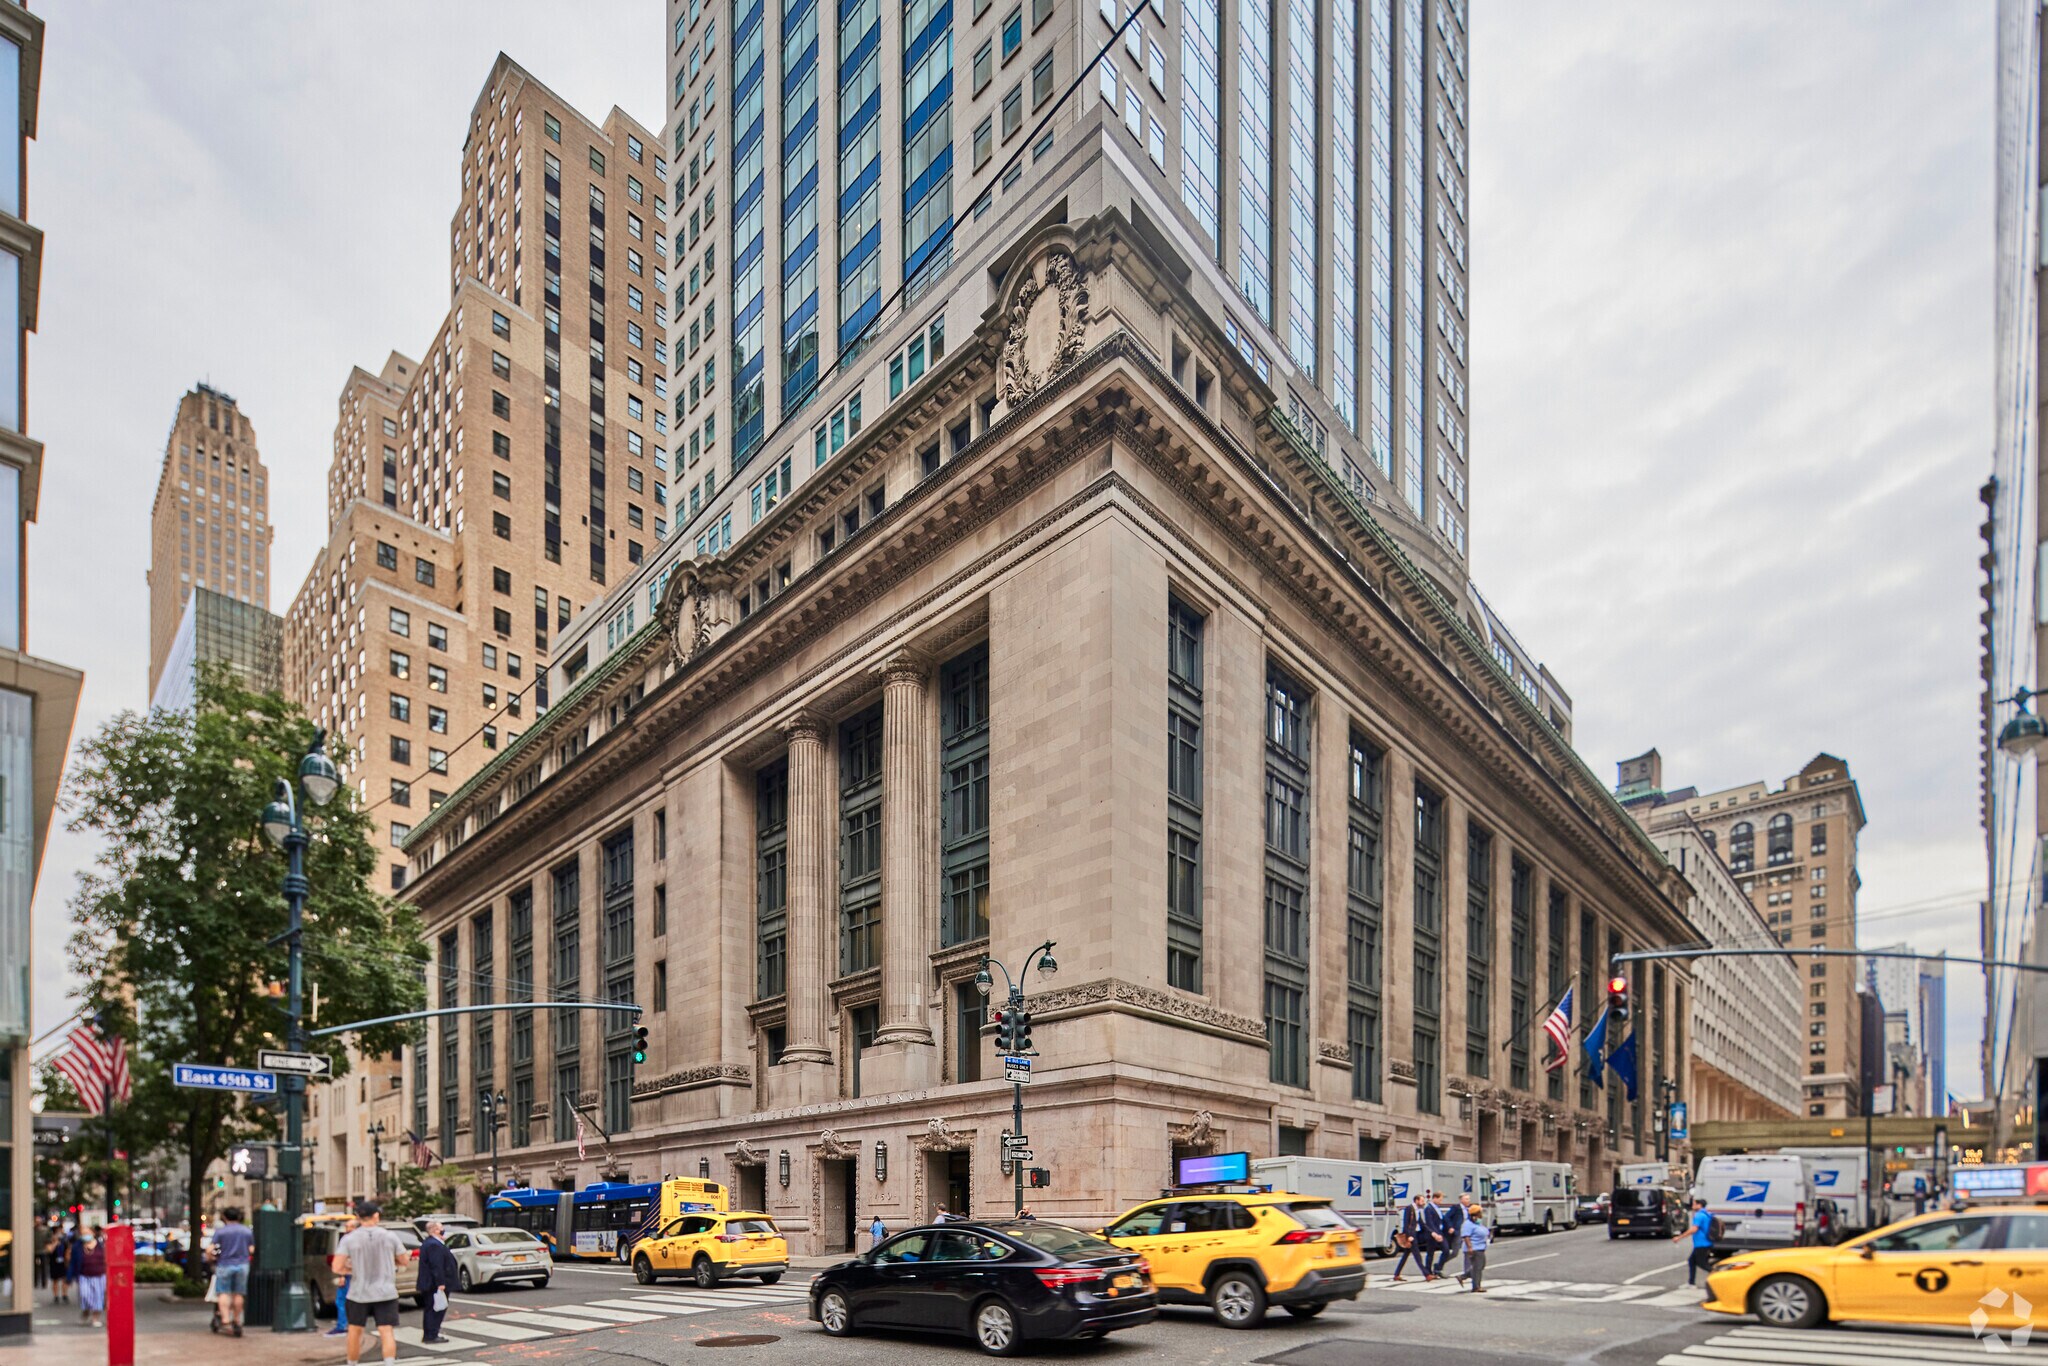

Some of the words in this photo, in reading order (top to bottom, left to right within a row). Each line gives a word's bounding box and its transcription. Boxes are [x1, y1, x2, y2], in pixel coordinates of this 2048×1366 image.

[300, 1060, 319, 1069] WAY
[180, 1069, 215, 1084] East
[218, 1072, 250, 1088] 45th
[253, 1075, 270, 1089] St
[772, 1101, 854, 1120] LEXINGTON
[864, 1090, 928, 1107] AVENUE
[1919, 1270, 1944, 1291] T
